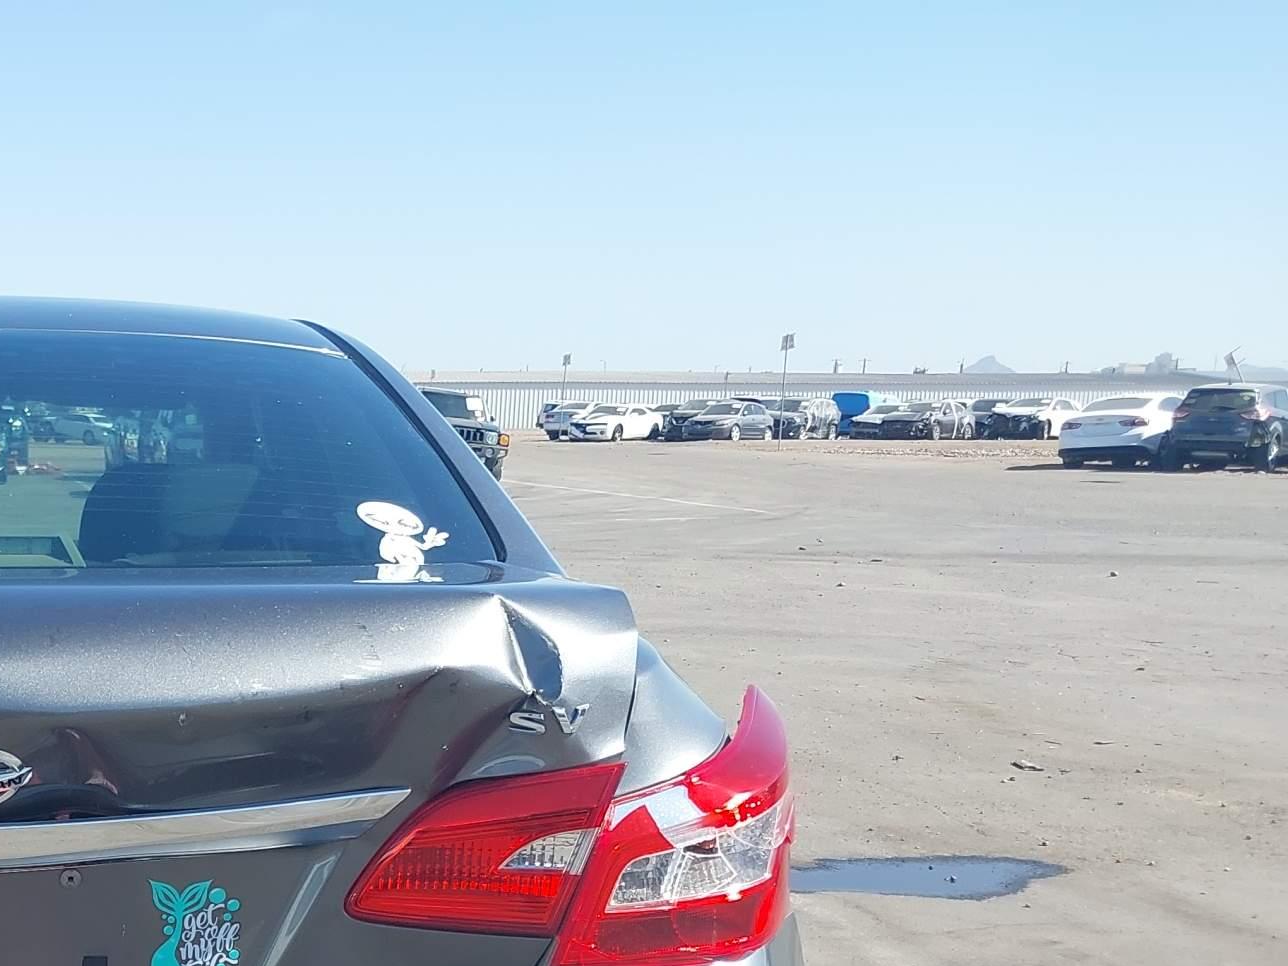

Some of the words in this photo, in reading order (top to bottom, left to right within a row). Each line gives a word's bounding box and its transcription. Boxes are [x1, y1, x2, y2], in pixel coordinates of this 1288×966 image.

[508, 703, 589, 734] SV
[182, 904, 225, 942] get
[205, 922, 240, 950] off
[180, 937, 213, 962] my
